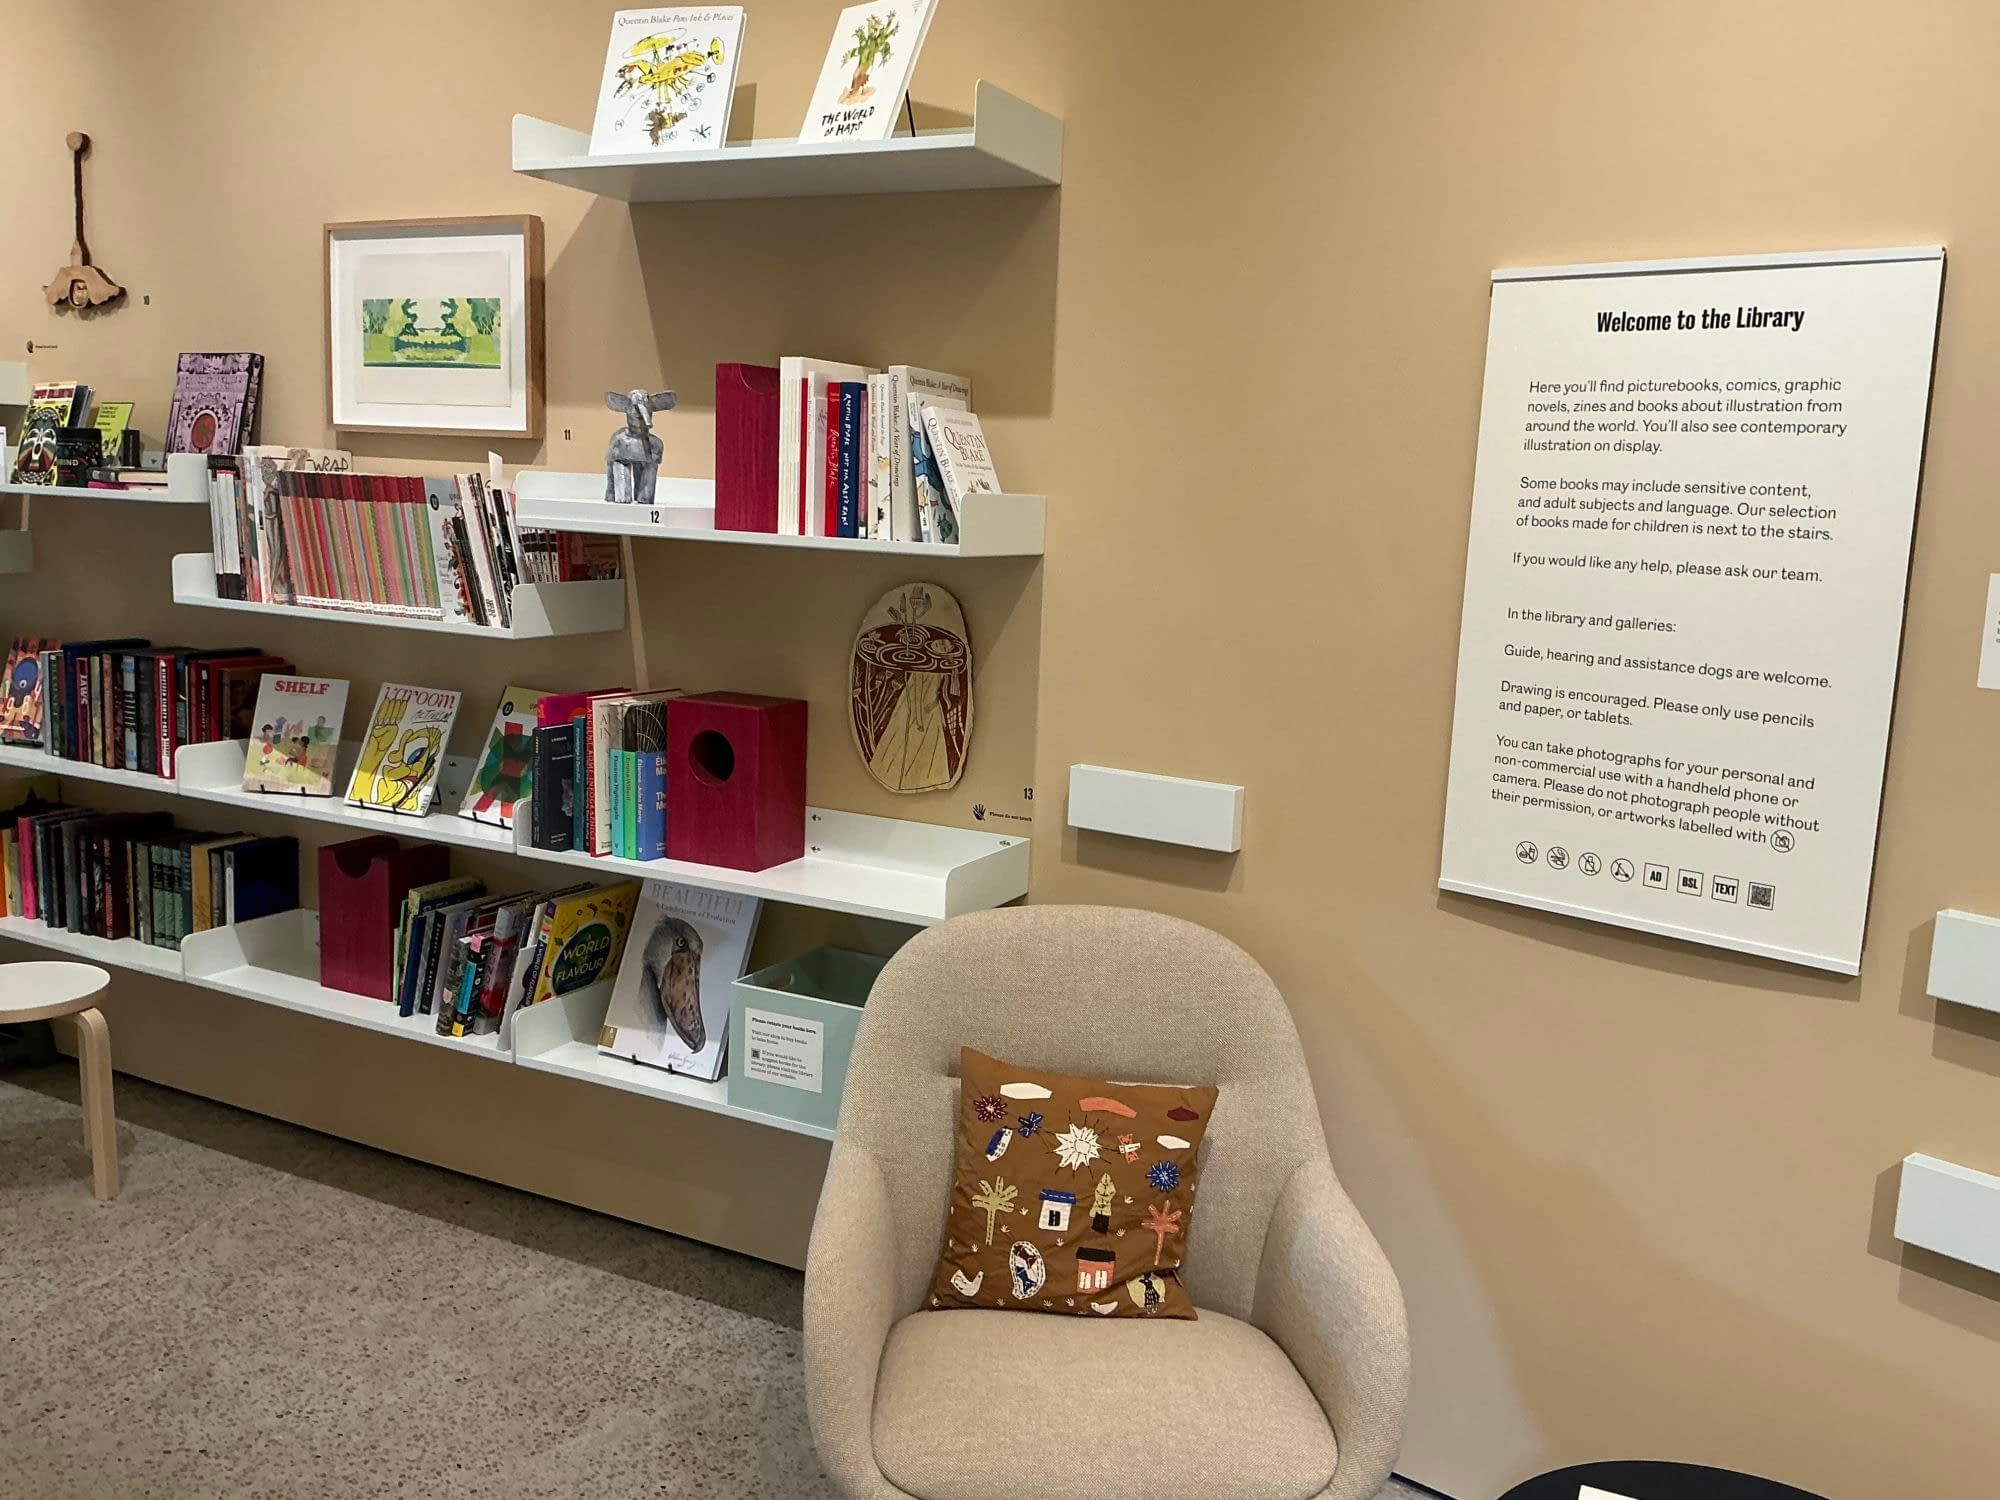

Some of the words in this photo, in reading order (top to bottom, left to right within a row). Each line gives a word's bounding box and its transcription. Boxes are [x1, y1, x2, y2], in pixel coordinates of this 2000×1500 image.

[618, 16, 649, 26] Quentin
[650, 15, 671, 24] Blake
[704, 13, 711, 21] &
[822, 111, 841, 126] THE
[843, 106, 874, 121] WORLD
[836, 121, 863, 136] HATS
[1597, 310, 1671, 332] Welcome
[1676, 309, 1695, 330] to
[1701, 307, 1731, 329] the
[1735, 305, 1805, 332] Library
[891, 375, 899, 404] Quentin
[1529, 380, 1561, 393] Here
[1599, 379, 1624, 392] find
[1626, 378, 1722, 394] picturebooks,
[1725, 378, 1780, 393] comics,
[1784, 377, 1841, 394] graphic
[1527, 400, 1570, 413] novels,
[1572, 399, 1606, 412] zines
[1608, 399, 1634, 412] and
[1637, 399, 1678, 411] books
[1681, 399, 1722, 412] about
[1725, 398, 1802, 412] illustration
[1806, 398, 1842, 412] from
[564, 429, 571, 441] 11
[944, 426, 985, 450] QUENTIN
[1524, 419, 1570, 431] around
[1573, 419, 1594, 431] the
[1597, 419, 1638, 431] world.
[1680, 419, 1709, 432] also
[1711, 422, 1737, 432] see
[1740, 420, 1847, 437] contemporary
[928, 417, 945, 456] QUENTIN
[940, 458, 953, 482] BLAKE
[959, 446, 985, 462] BLAKE
[1523, 438, 1590, 451] illustration
[1593, 442, 1610, 451] on
[1613, 439, 1662, 455] display.
[312, 455, 349, 472] WRAP
[1519, 476, 1556, 489] Some
[1559, 477, 1598, 490] books
[1601, 481, 1629, 494] may
[1631, 479, 1680, 492] include
[1683, 480, 1746, 494] sensitive
[1749, 483, 1810, 498] content,
[650, 511, 659, 524] 12
[1517, 496, 1541, 507] and
[1543, 496, 1576, 509] adult
[1578, 497, 1634, 513] subjects
[1637, 499, 1663, 512] and
[1666, 499, 1732, 517] language.
[1737, 502, 1765, 516] Our
[1768, 504, 1836, 519] selection
[1515, 514, 1529, 526] of
[1531, 514, 1569, 528] books
[1572, 517, 1608, 529] made
[1611, 517, 1631, 530] for
[1633, 519, 1688, 533] children
[1692, 520, 1703, 534] is
[1706, 523, 1737, 535] next
[1741, 524, 1756, 536] to
[1760, 524, 1784, 537] the
[1787, 526, 1833, 540] stairs.
[1512, 551, 1521, 563] If
[1522, 555, 1545, 567] you
[1548, 555, 1586, 567] would
[1589, 555, 1611, 568] like
[1614, 560, 1637, 573] any
[1640, 559, 1672, 574] help,
[1675, 561, 1721, 575] please
[1724, 564, 1748, 577] ask
[1752, 568, 1777, 578] our
[1781, 567, 1822, 582] team.
[1507, 607, 1518, 619] In
[1521, 608, 1542, 621] the
[1544, 610, 1586, 627] library
[1588, 615, 1612, 626] and
[1615, 616, 1676, 632] galleries:
[1504, 643, 1543, 661] Guide,
[1546, 647, 1594, 666] hearing
[1597, 654, 1621, 666] and
[1624, 657, 1695, 673] assistance
[1698, 662, 1732, 680] dogs
[1735, 669, 1759, 680] are
[1763, 670, 1831, 688] welcome.
[80, 674, 88, 705] JAWS
[275, 680, 330, 695] SHELF
[1498, 700, 1521, 711] and
[1523, 704, 1563, 719] paper,
[1566, 709, 1581, 718] or
[1583, 708, 1632, 725] tablets.
[1500, 680, 1552, 700] Drawing
[1555, 685, 1565, 698] is
[1567, 690, 1649, 708] encouraged.
[1653, 696, 1698, 713] Please
[1701, 704, 1731, 720] only
[1734, 709, 1759, 721] use
[1762, 712, 1814, 727] pencils
[1496, 734, 1518, 748] You
[1521, 740, 1542, 751] can
[1546, 741, 1573, 755] take
[1576, 746, 1661, 768] photographs
[1664, 756, 1684, 770] for
[1685, 763, 1718, 775] your
[1721, 768, 1784, 785] personal
[1787, 777, 1814, 789] and
[1494, 755, 1595, 777] non-commercial
[1598, 770, 1621, 781] use
[1624, 772, 1652, 786] with
[1655, 778, 1663, 787] a
[1666, 776, 1730, 797] handheld
[1733, 787, 1778, 804] phone
[1781, 797, 1798, 807] or
[1024, 787, 1033, 800] 13
[1492, 773, 1540, 788] camera.
[1543, 777, 1584, 794] Please
[1586, 784, 1603, 797] do
[1606, 790, 1628, 801] not
[1630, 792, 1709, 814] photograph
[1712, 806, 1760, 822] people
[1764, 812, 1819, 832] without
[1491, 788, 1520, 802] their
[1522, 795, 1594, 816] permission,
[1597, 807, 1612, 817] or
[1614, 810, 1675, 828] artworks
[1678, 817, 1732, 837] labelled
[1736, 828, 1766, 843] with
[1650, 871, 1662, 882] AD
[1682, 876, 1698, 889] BSL
[1715, 883, 1737, 896] TEXT
[563, 935, 610, 960] WORLD
[556, 957, 604, 981] FLAVOUR
